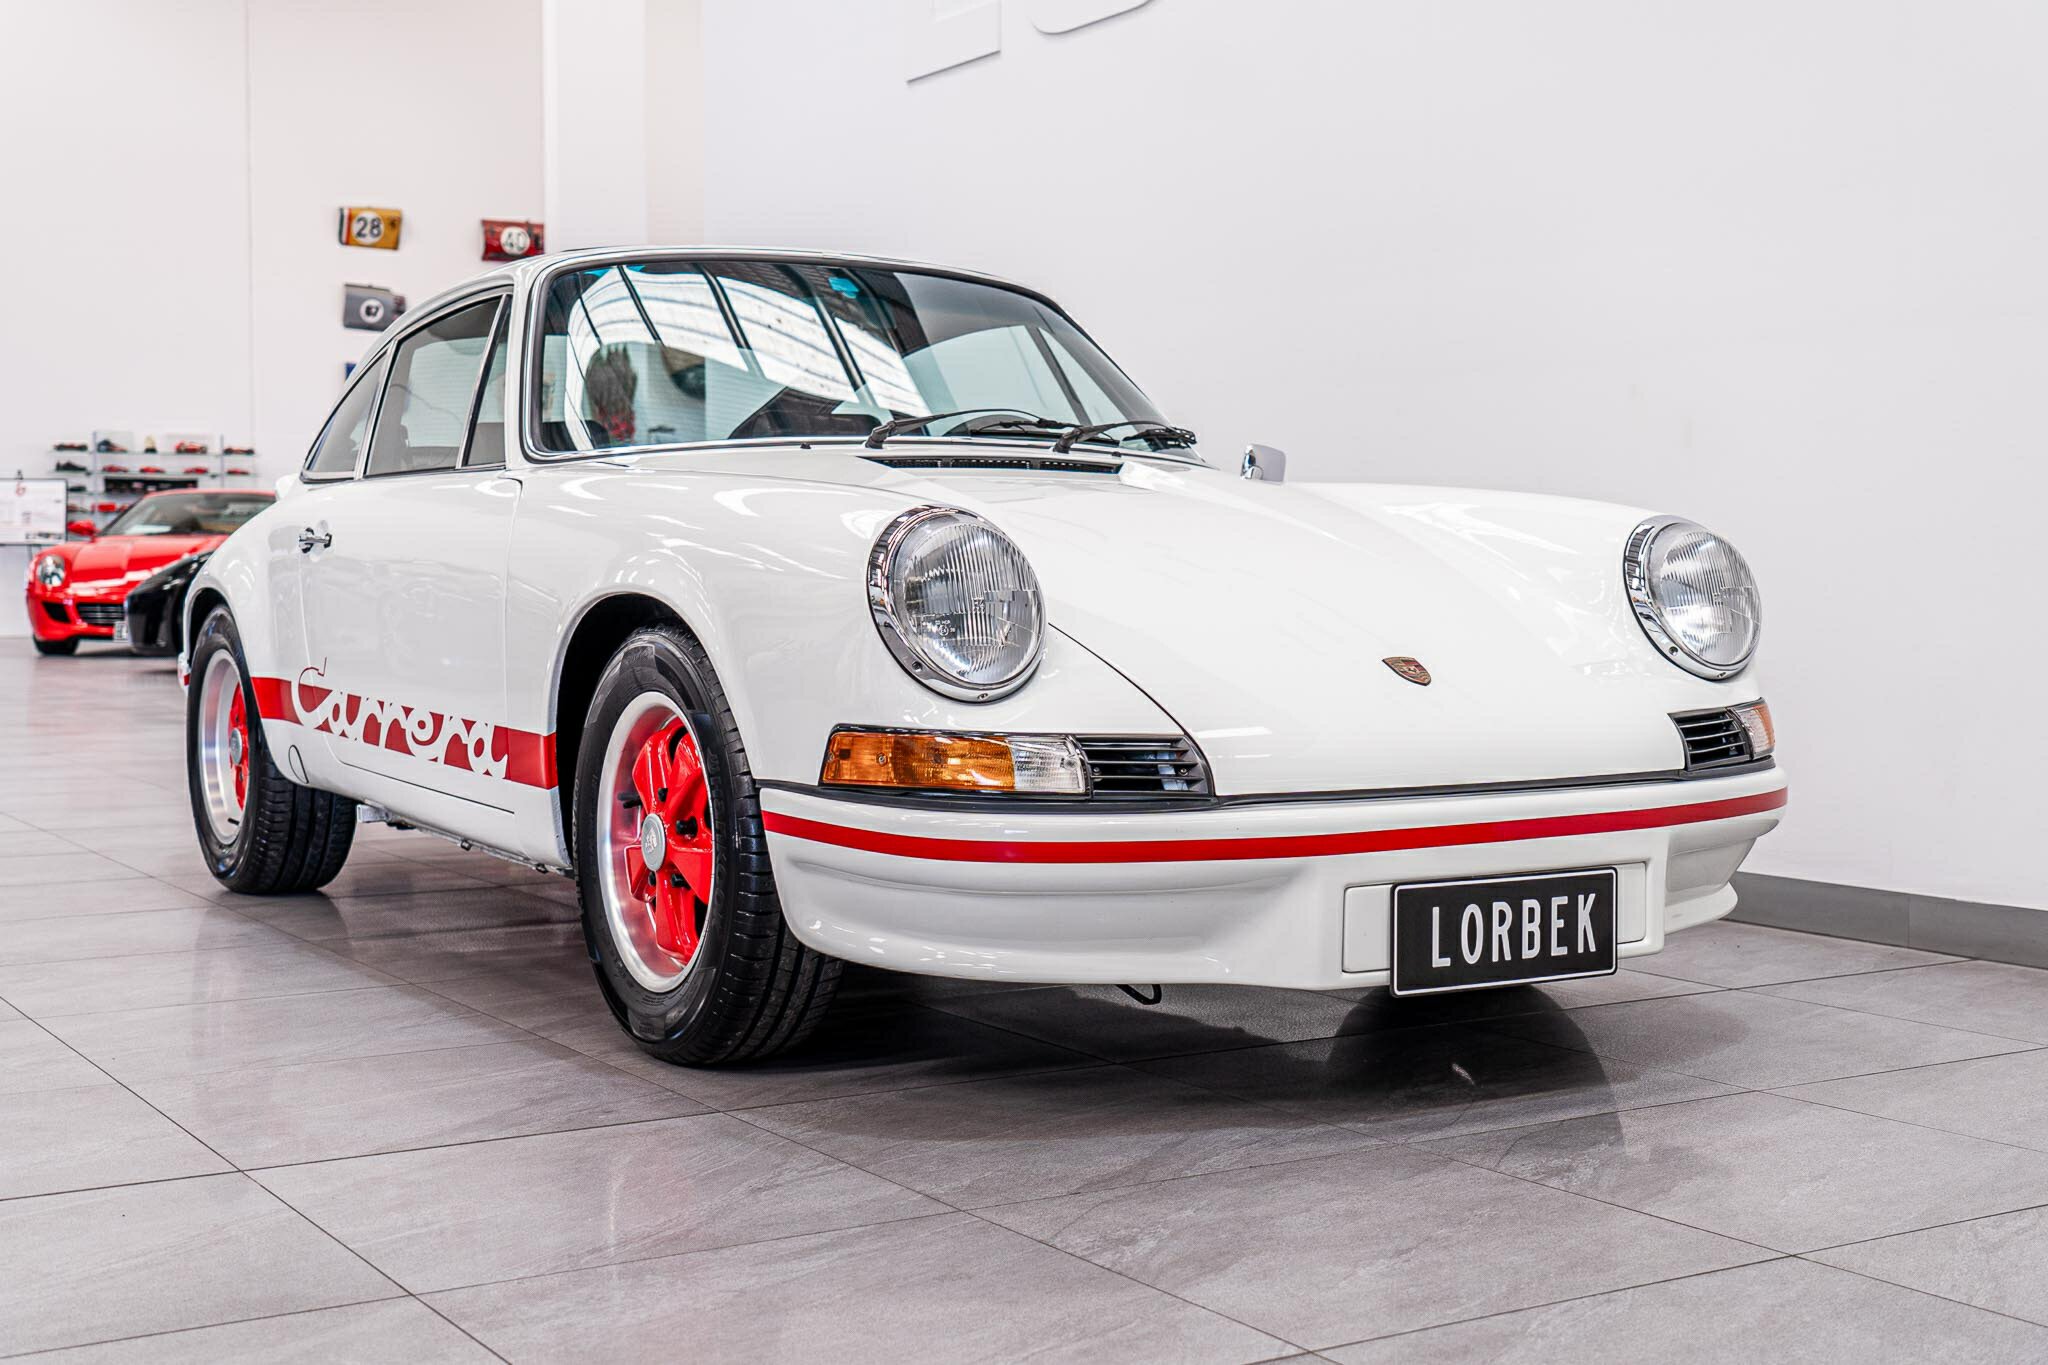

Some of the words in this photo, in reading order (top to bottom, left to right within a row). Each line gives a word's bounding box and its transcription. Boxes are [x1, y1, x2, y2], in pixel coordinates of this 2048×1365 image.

[355, 216, 382, 238] 28
[503, 231, 528, 251] 40
[290, 657, 508, 780] Carrera
[1431, 893, 1597, 968] LORBEK
